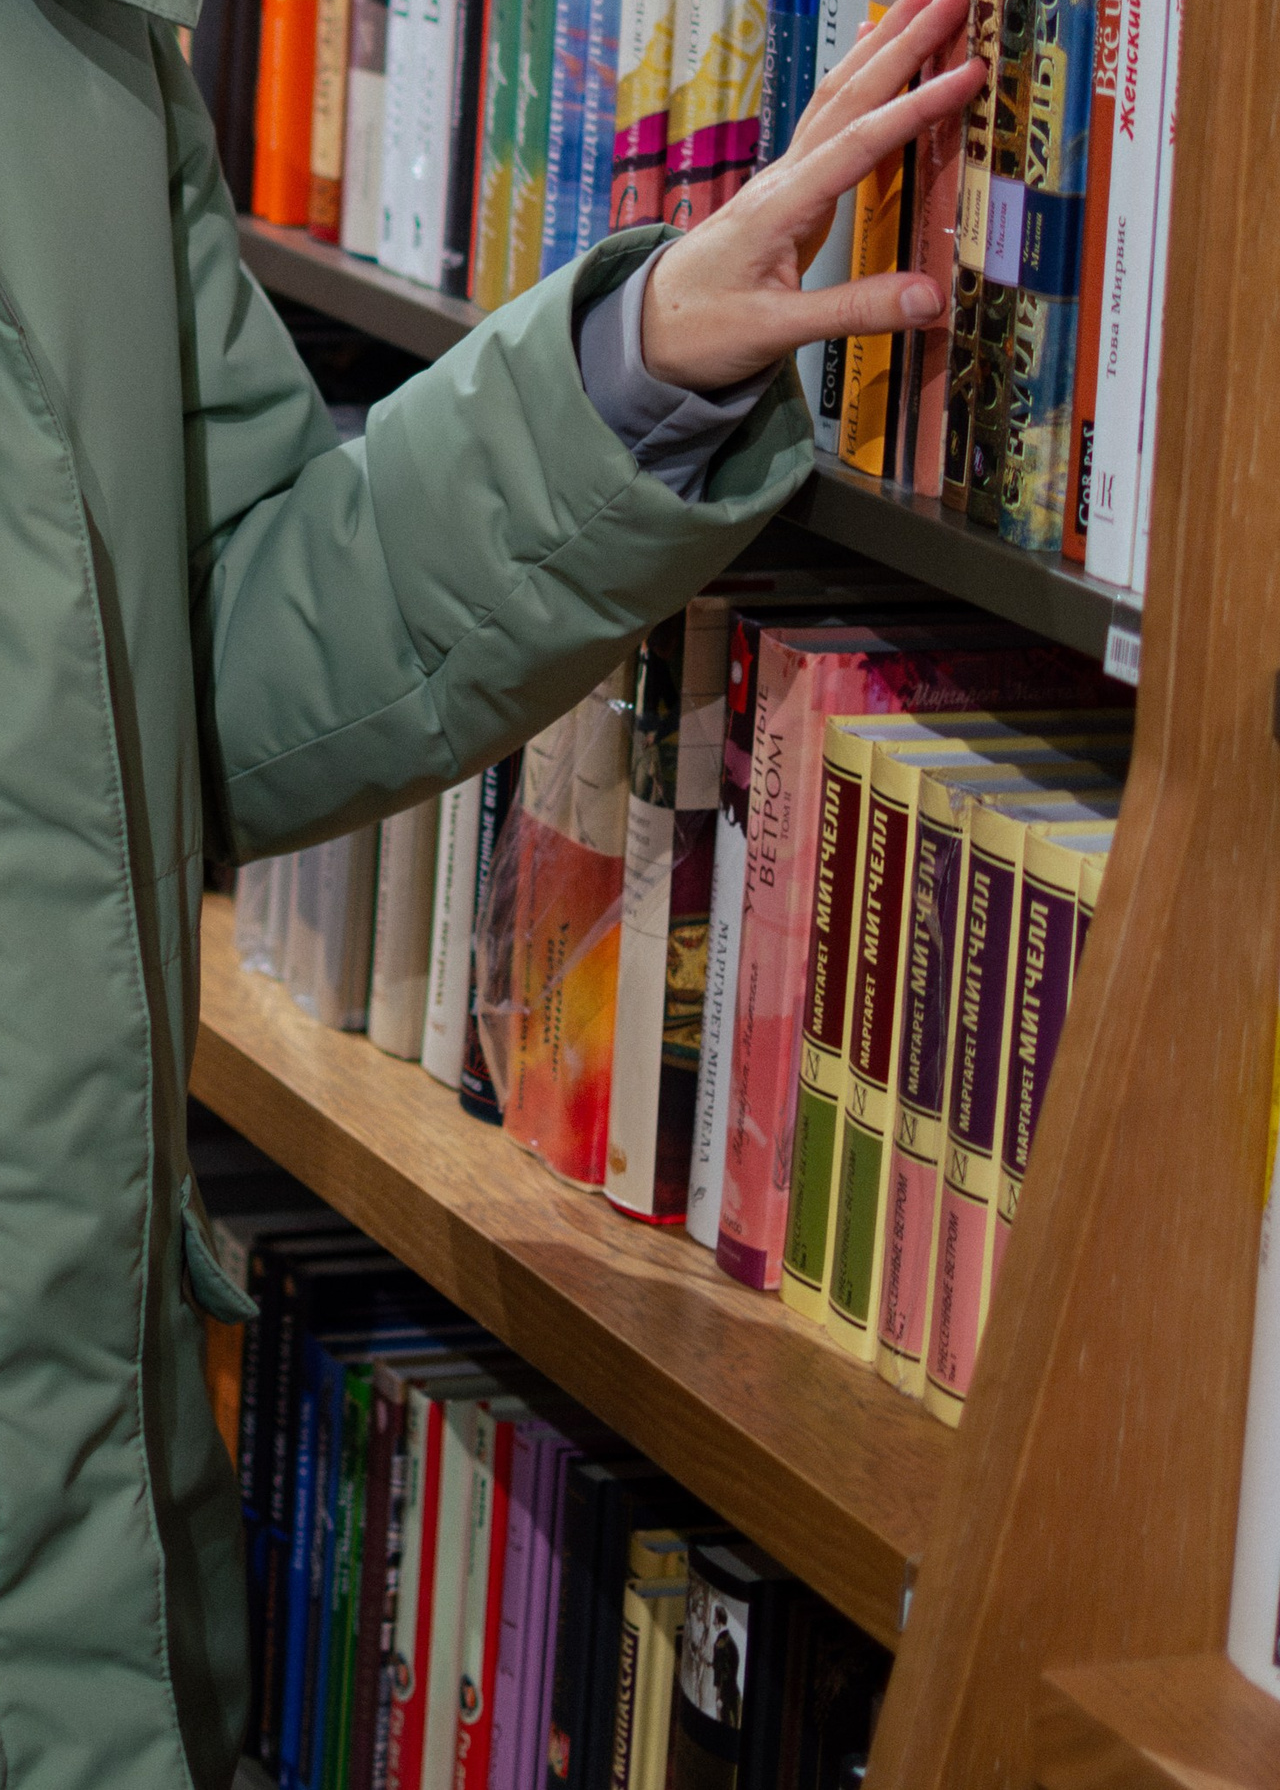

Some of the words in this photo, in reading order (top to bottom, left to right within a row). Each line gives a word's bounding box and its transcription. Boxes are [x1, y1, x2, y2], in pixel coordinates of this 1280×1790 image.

[759, 24, 777, 162] Нью-Йорк
[542, 69, 565, 246] ПОСЛЕДНЕЕ
[971, 189, 982, 246] Милош
[995, 202, 1008, 259] Милош
[1030, 212, 1043, 272] Милош
[1111, 216, 1127, 315] Мирвис
[822, 338, 839, 409] CORP
[1106, 322, 1120, 379] Това
[759, 734, 785, 888] ВЕТРОМ
[779, 806, 792, 841] ТОМ
[816, 779, 842, 932] МИТЧЕЛЛ
[862, 810, 889, 965] МИТЧЕЛЛ
[910, 839, 938, 997] МИТЧЕЛЛ
[710, 920, 730, 1043] МАРГАРЕТ
[812, 940, 831, 1037] МАРГАРЕТ
[962, 871, 992, 1034] МИТЧЕЛЛ
[1018, 901, 1050, 1065] МИТЧЕЛЛ
[858, 974, 877, 1070] МАРГАРЕТ
[906, 999, 926, 1097] МАРГАРЕТ
[699, 1048, 720, 1165] МИТЧЕЛЛ
[958, 1035, 978, 1133] МАРГАРЕТ
[1015, 1067, 1036, 1167] МАРГАРЕТ
[892, 1172, 909, 1238] ВЕТРОМ
[885, 1242, 904, 1334] УНЕСЕННЫЕ
[936, 1284, 954, 1377] УНЕСЕННЫЕ
[945, 1210, 960, 1279] ВЕТРОМ
